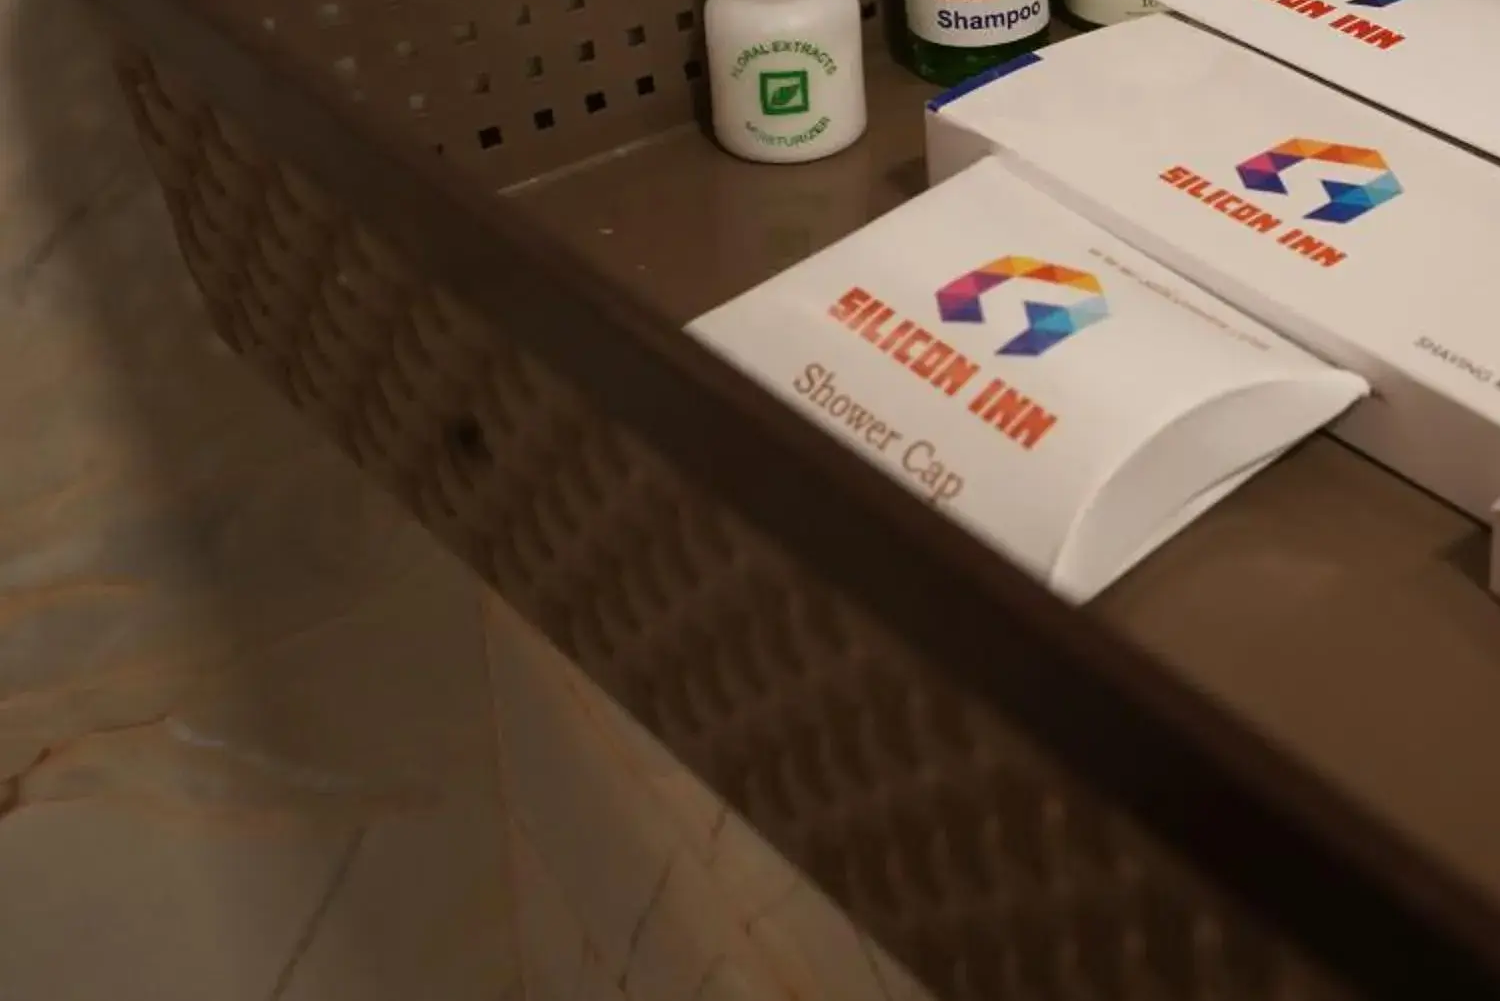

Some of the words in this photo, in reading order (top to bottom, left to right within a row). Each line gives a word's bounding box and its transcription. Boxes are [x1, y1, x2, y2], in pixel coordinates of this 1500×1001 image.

[937, 0, 1041, 30] Shampoo
[1328, 13, 1406, 50] INN
[1158, 165, 1282, 234] SILICON
[1276, 228, 1348, 268] INN
[828, 286, 980, 396] SILICON
[967, 376, 1058, 452] INN
[793, 362, 903, 453] Shower
[901, 439, 965, 503] Cap
